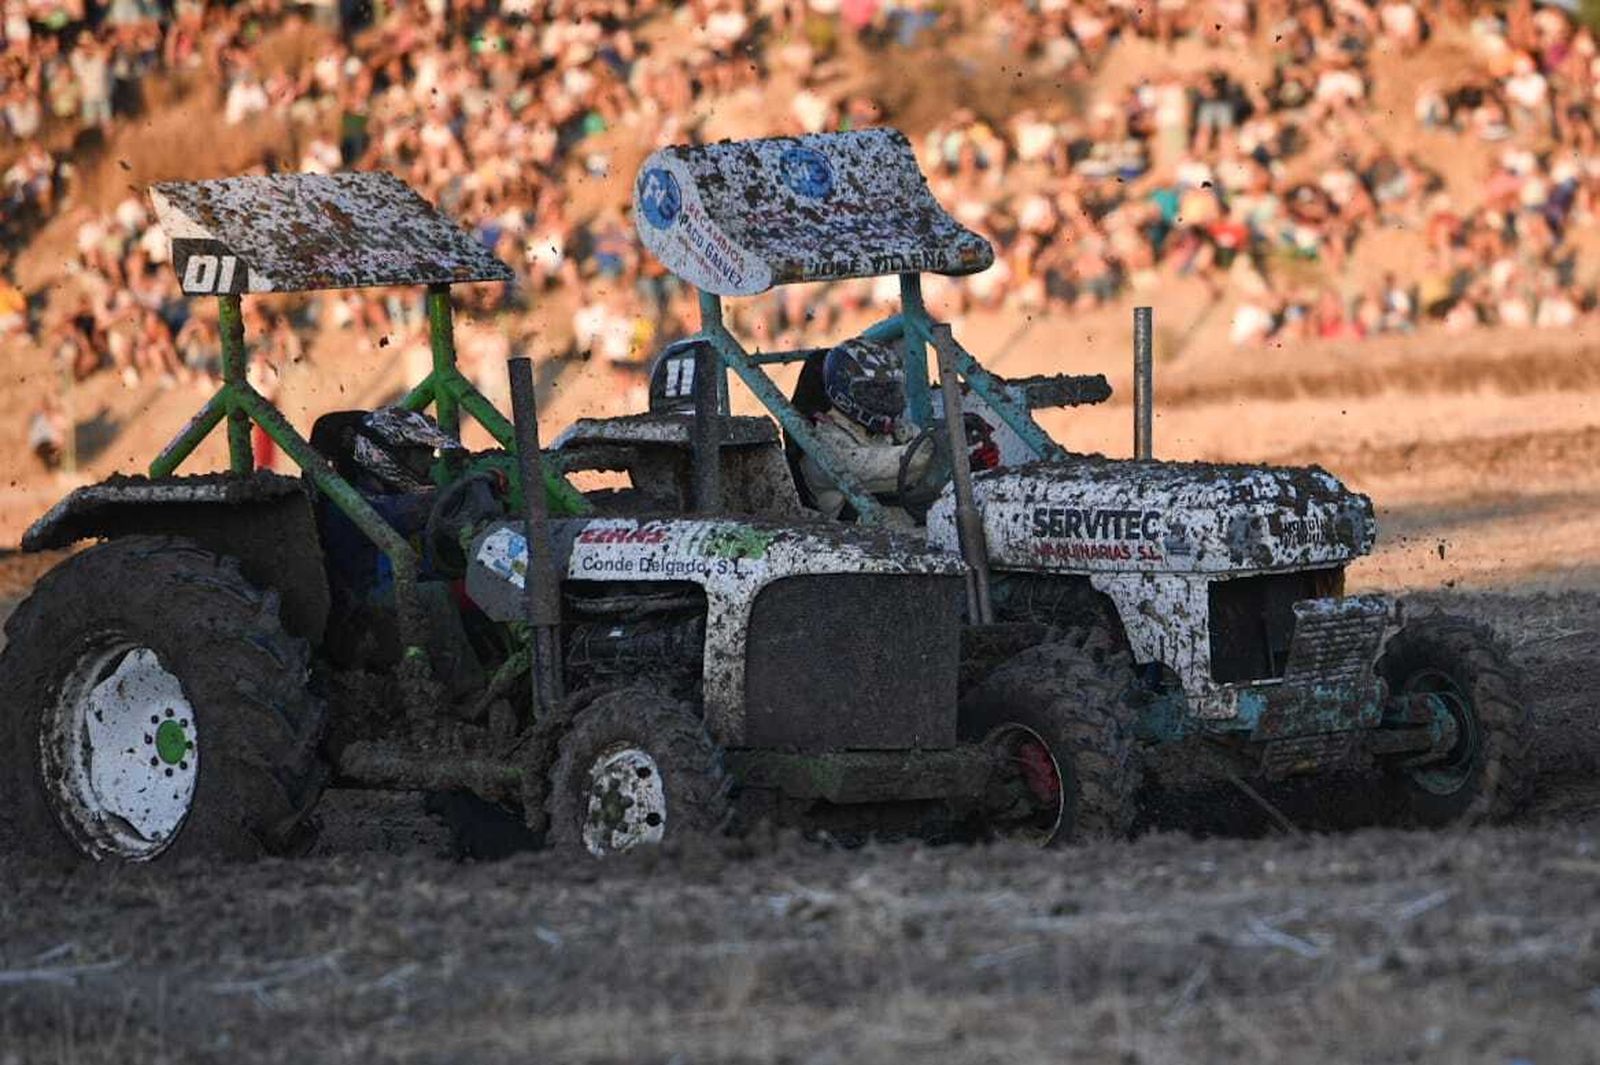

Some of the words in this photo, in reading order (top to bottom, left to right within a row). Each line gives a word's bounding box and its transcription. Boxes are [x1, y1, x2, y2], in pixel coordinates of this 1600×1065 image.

[183, 255, 237, 292] 01
[665, 358, 695, 397] 11
[1032, 507, 1161, 540] SERVITEC
[582, 556, 634, 571] Conde
[1034, 543, 1132, 560] MAQUINARIAS
